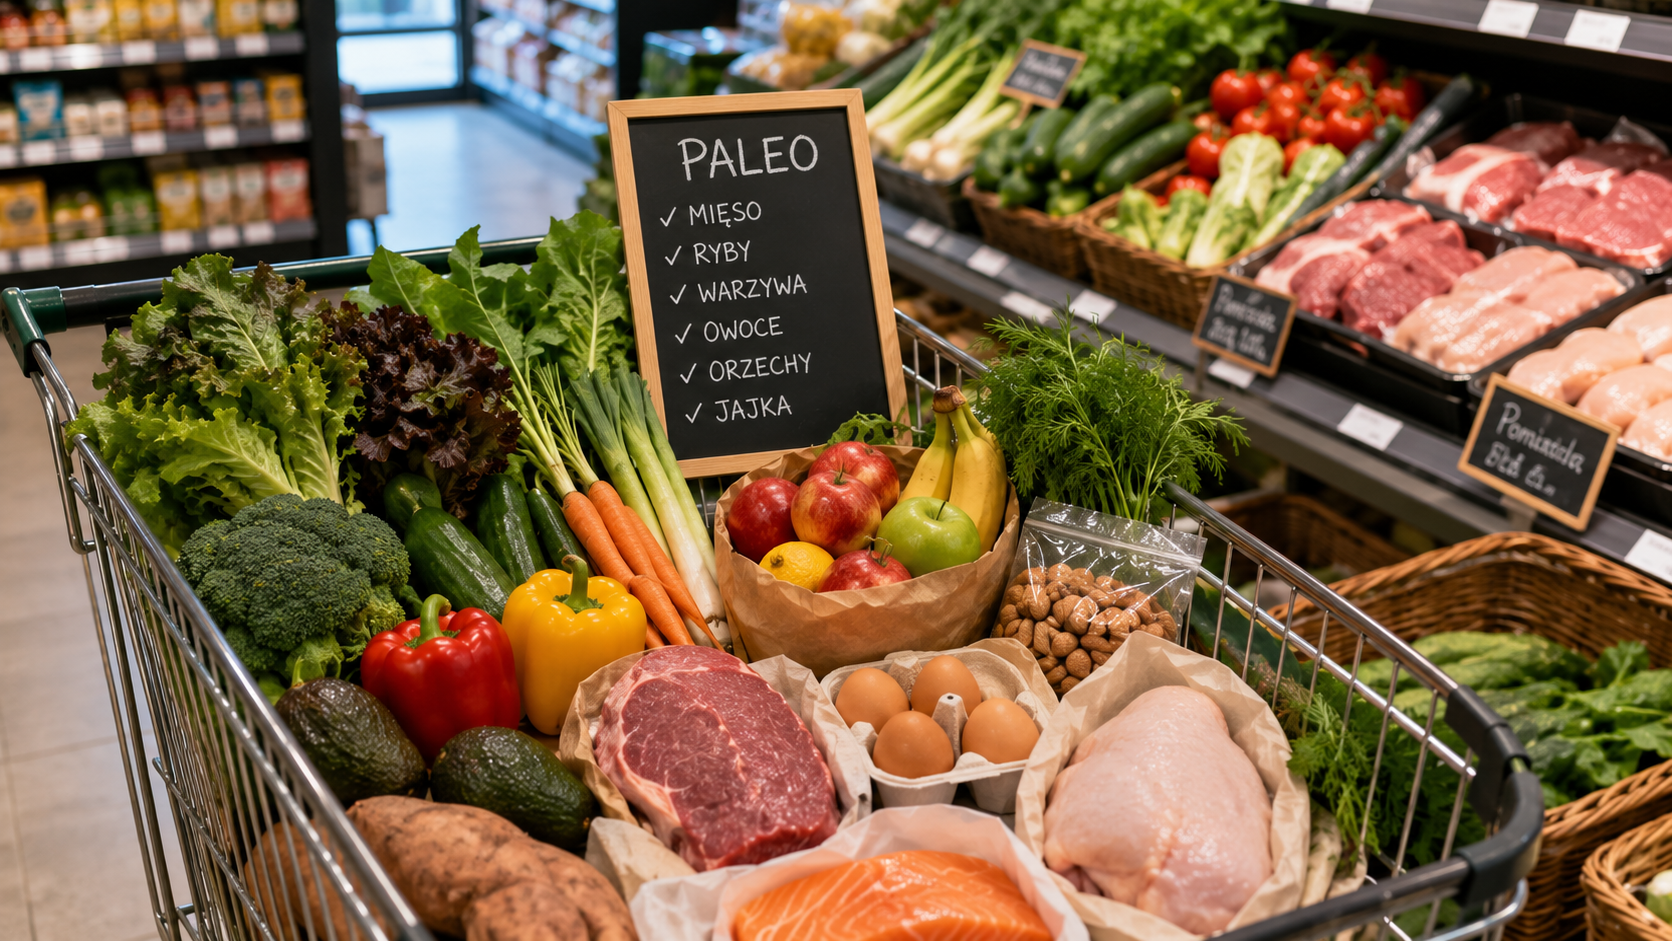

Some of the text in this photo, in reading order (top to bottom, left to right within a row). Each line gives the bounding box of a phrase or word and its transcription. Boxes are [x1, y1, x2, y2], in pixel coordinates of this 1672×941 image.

[677, 134, 819, 182] PALEO
[688, 200, 762, 228] MIĘSO
[692, 239, 751, 265] RYBY
[697, 273, 808, 303] WARZYWA
[703, 315, 784, 343] OWOCE
[709, 352, 812, 382] ORZECHY
[714, 394, 793, 423] JAJKA
